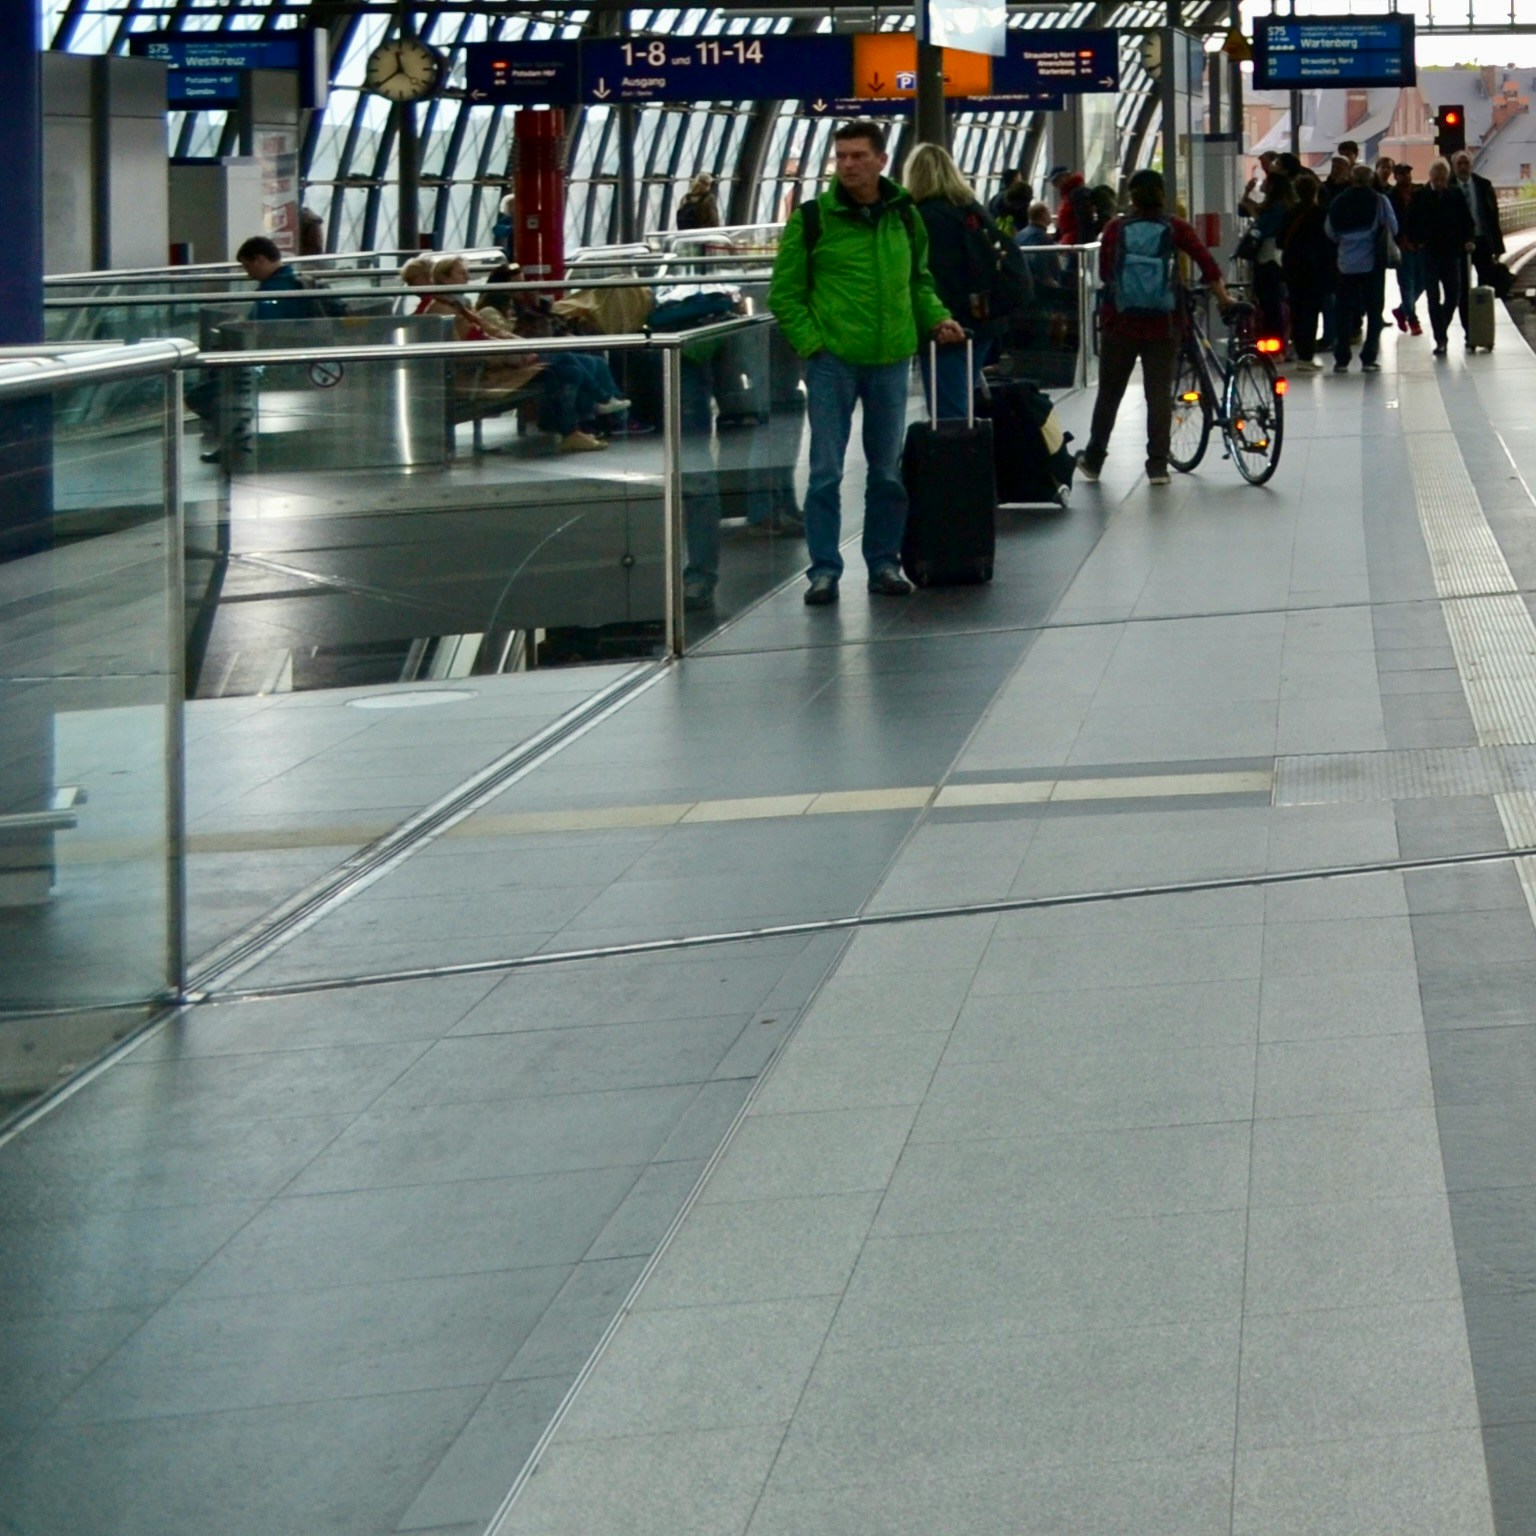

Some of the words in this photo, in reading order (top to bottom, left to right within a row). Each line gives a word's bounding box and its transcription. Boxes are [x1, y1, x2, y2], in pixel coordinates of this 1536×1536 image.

[148, 43, 170, 54] S75
[1300, 38, 1358, 49] Wartenberg
[620, 41, 667, 66] 1-8
[671, 55, 691, 66] und
[695, 40, 764, 65] 11-14
[185, 56, 246, 67] Westkreuz
[621, 76, 666, 88] Ausgang
[900, 76, 912, 88] P
